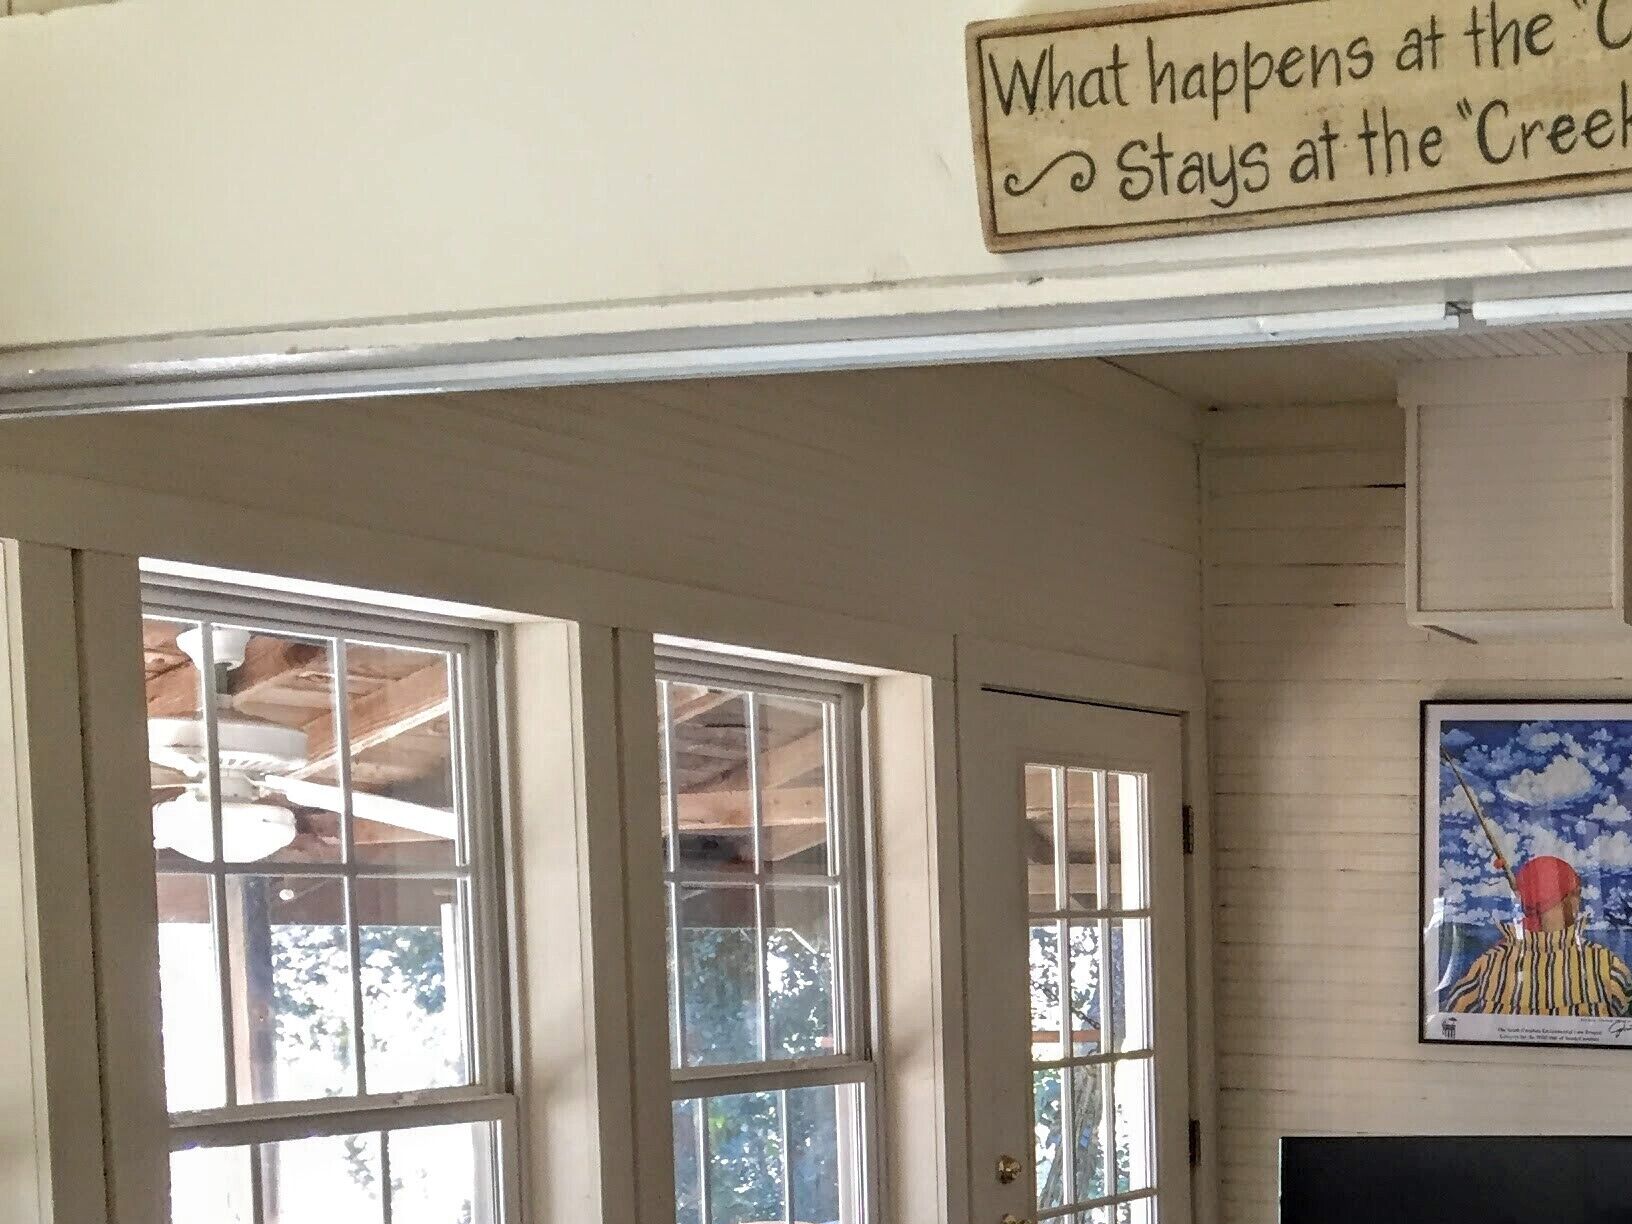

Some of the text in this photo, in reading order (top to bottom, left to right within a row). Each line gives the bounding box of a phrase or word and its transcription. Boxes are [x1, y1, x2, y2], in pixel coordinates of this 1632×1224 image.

[987, 43, 1130, 117] What
[1146, 34, 1375, 121] happens
[1395, 13, 1446, 71] at
[1463, 0, 1555, 68] the
[1115, 131, 1270, 208] Stays
[1288, 118, 1340, 182] at
[1357, 105, 1443, 176] the
